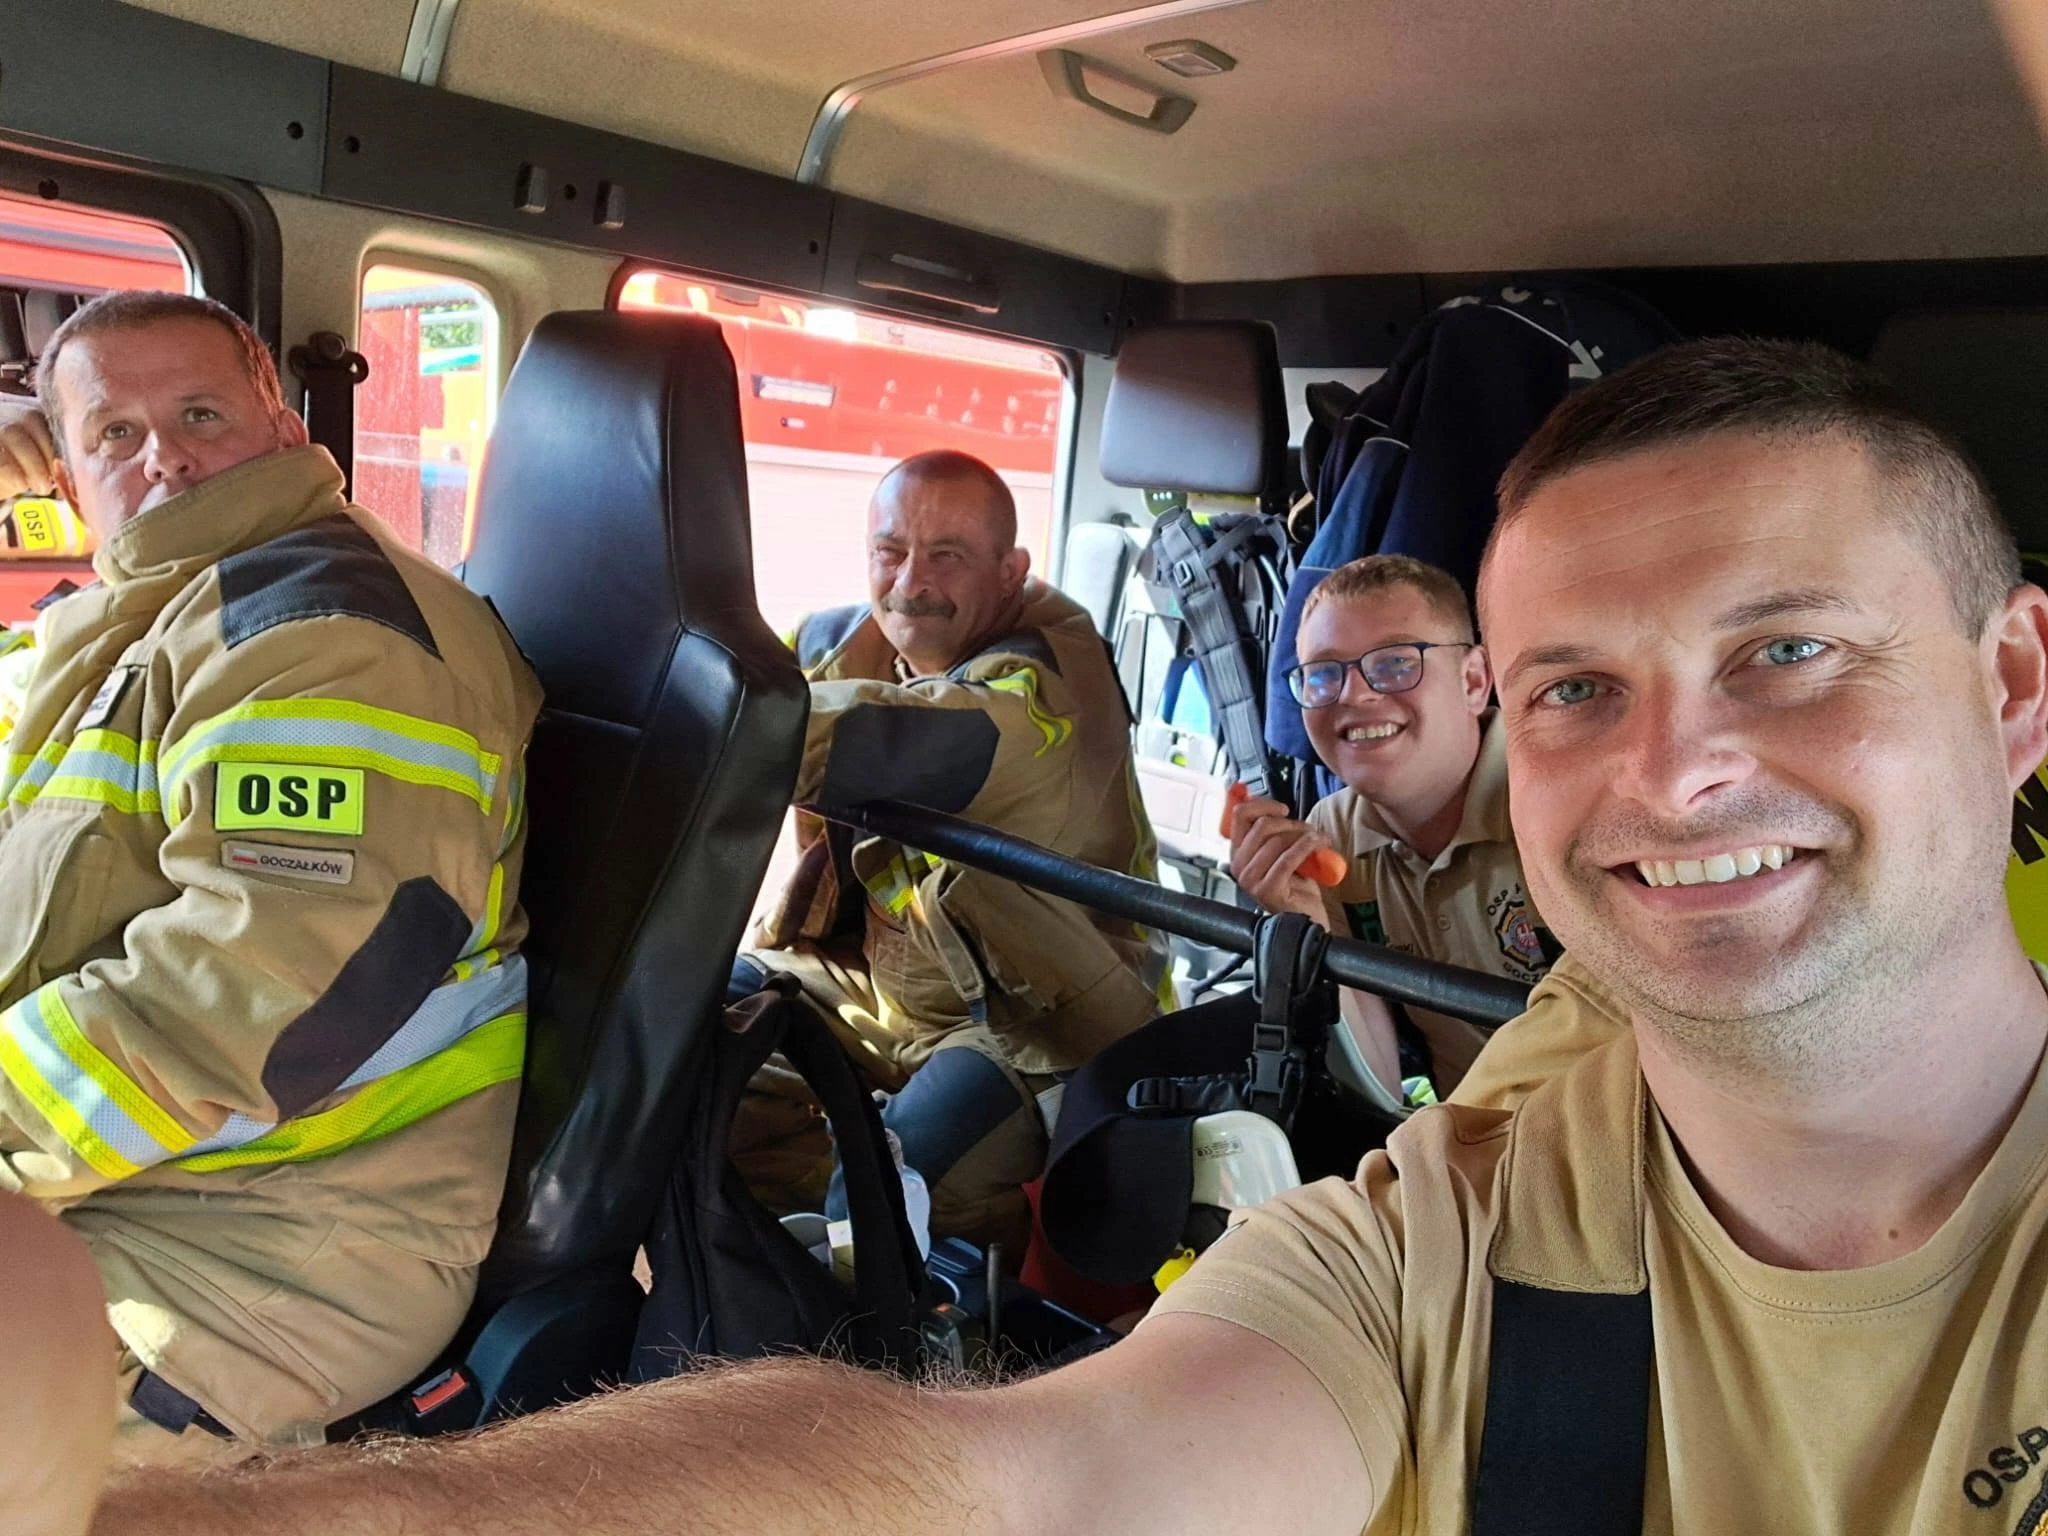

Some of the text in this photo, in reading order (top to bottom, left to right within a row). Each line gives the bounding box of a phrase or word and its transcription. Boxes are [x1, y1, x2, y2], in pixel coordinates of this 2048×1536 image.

[23, 510, 45, 541] OSP
[238, 773, 346, 820] OSP
[260, 855, 343, 875] GOCZAŁKÓW
[1487, 889, 1509, 916] OSP
[1503, 962, 1543, 982] GOCZ
[1963, 1426, 2048, 1508] OSP
